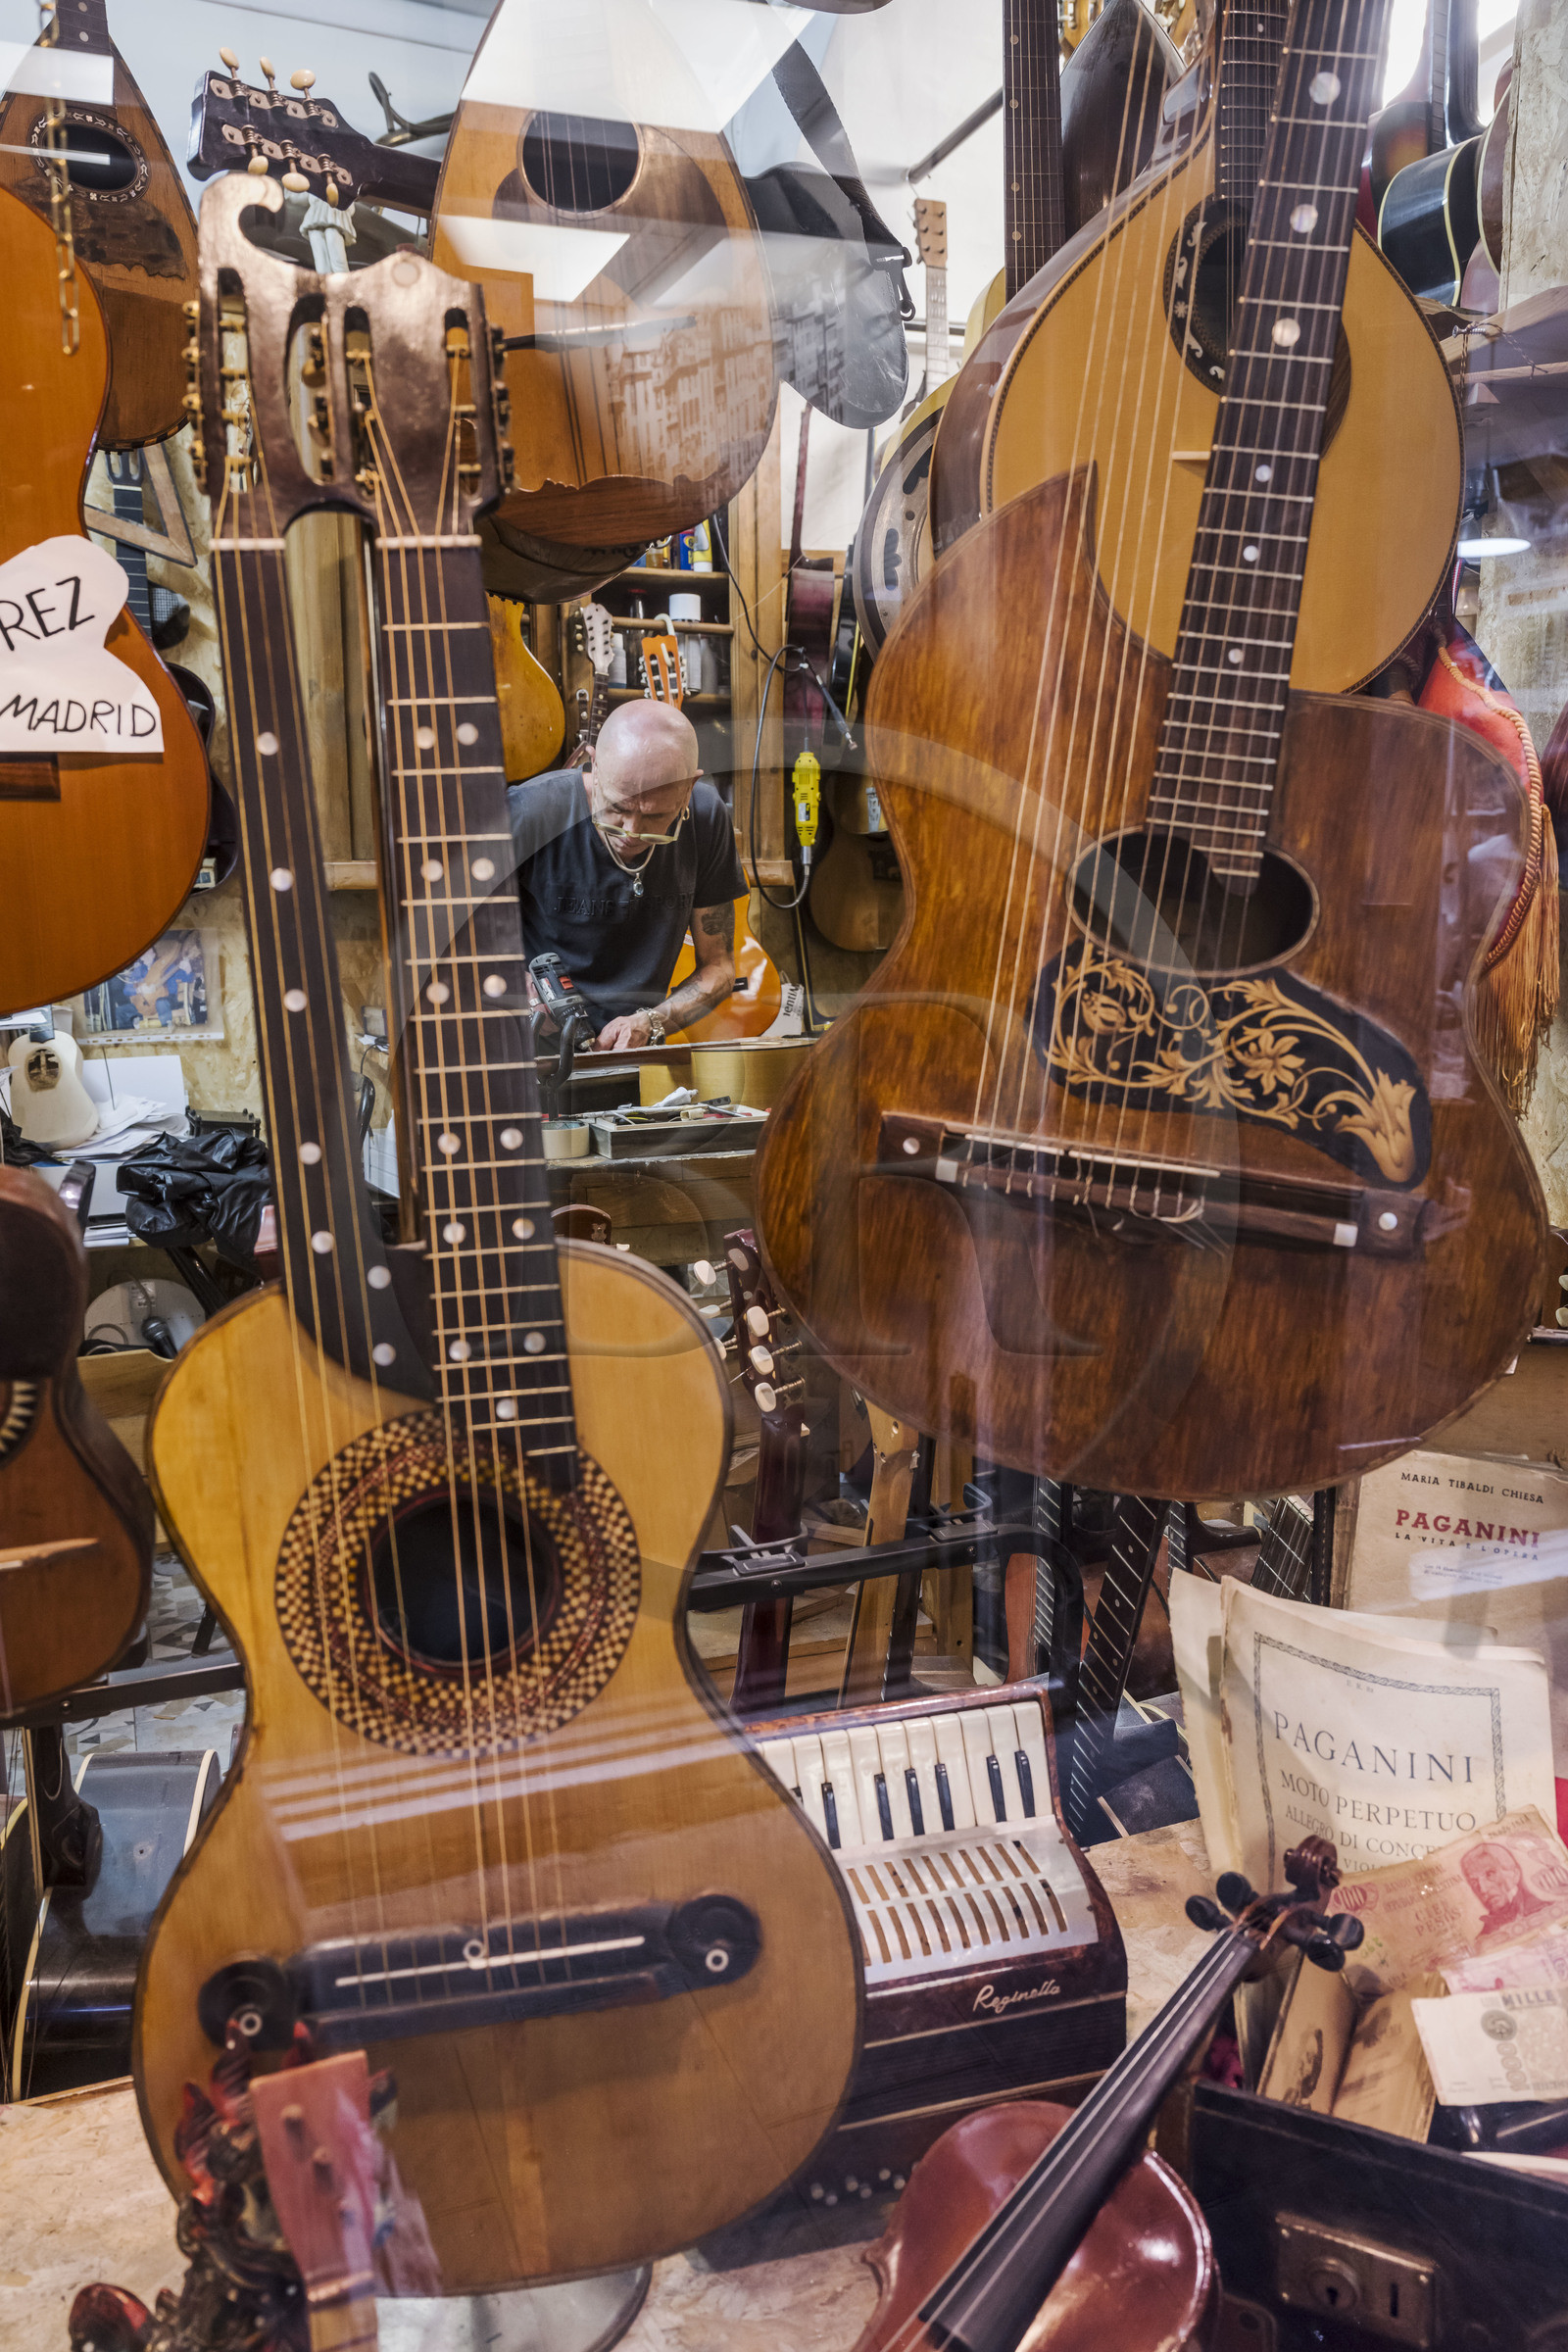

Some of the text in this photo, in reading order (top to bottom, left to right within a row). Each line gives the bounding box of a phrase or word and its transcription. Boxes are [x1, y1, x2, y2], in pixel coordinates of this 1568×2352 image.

[0, 694, 157, 737] MADRID
[1400, 1472, 1544, 1504] MARIA TIBALDI CHIESA
[1395, 1532, 1411, 1541] LA
[1421, 1536, 1456, 1547] VITA
[1396, 1508, 1541, 1548] PAGANINI
[1273, 1709, 1474, 1784] PAGANINI
[1279, 1769, 1330, 1808] MOTO
[1336, 1795, 1477, 1833] PERPETUO
[1285, 1804, 1443, 1860] ALLEGRO DI CONCE
[1415, 1907, 1462, 1937] PESOS
[972, 1978, 1061, 2014] Reginella
[1502, 1988, 1556, 2009] MILLE
